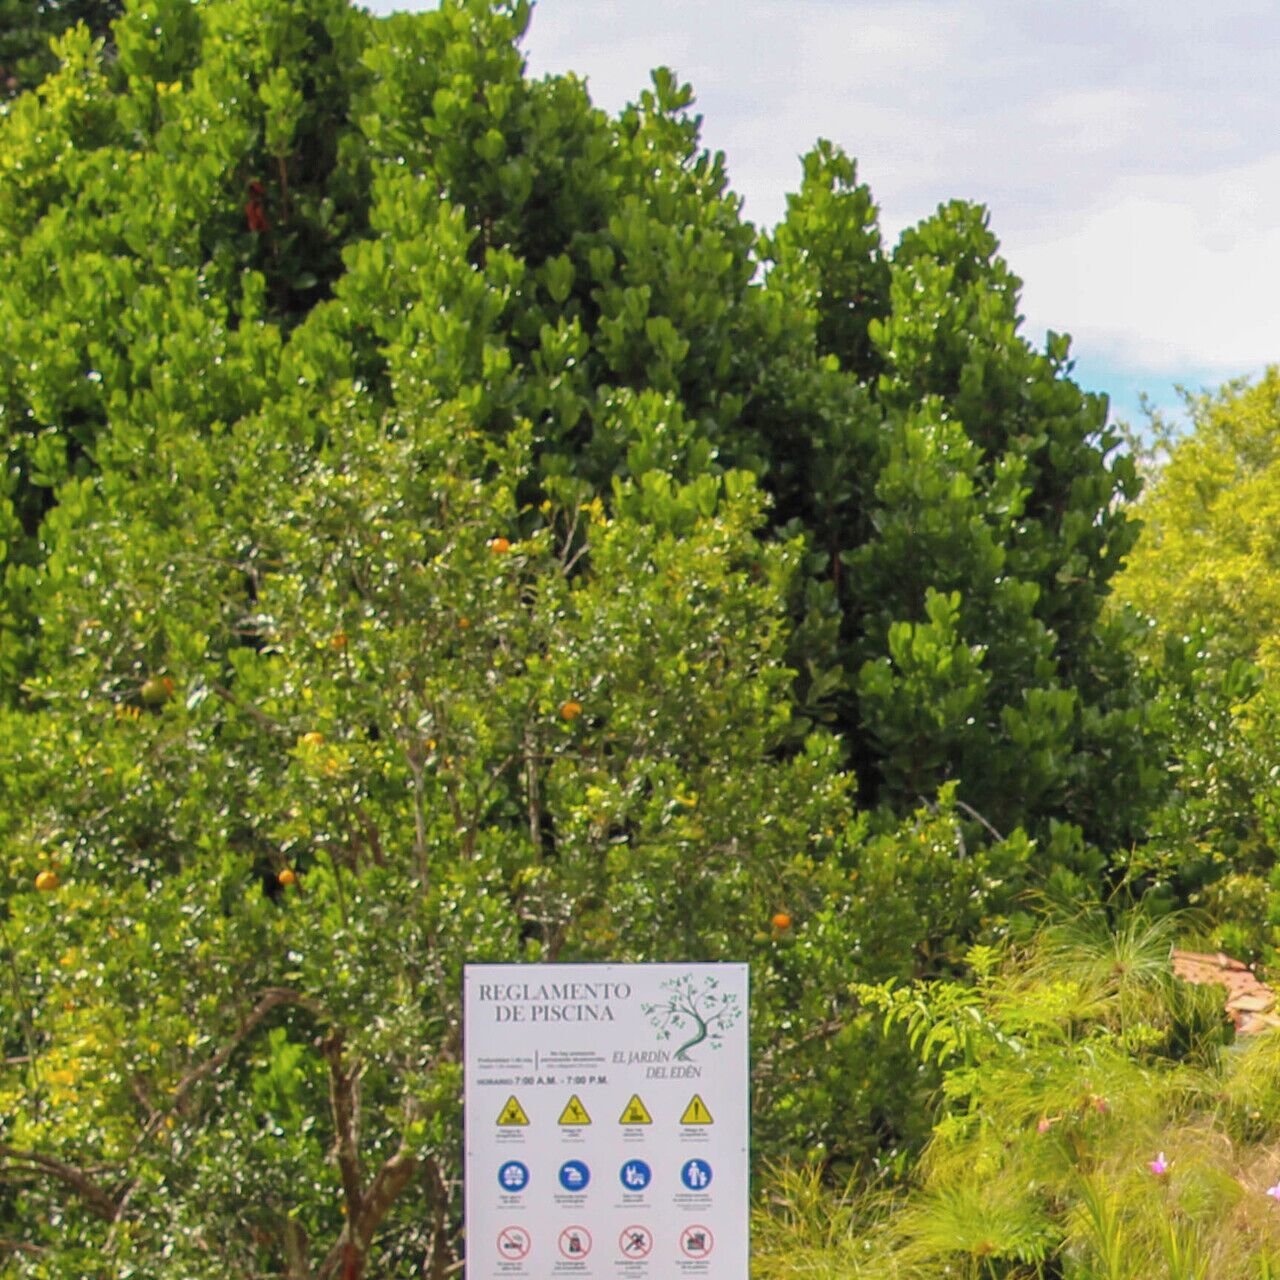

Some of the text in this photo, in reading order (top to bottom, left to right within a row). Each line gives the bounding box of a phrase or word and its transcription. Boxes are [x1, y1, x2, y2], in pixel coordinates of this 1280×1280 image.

[479, 983, 631, 1001] REGLAMENTO
[495, 1005, 614, 1022] DE PISCINA
[612, 1049, 670, 1066] EL JARDÍN
[514, 1076, 535, 1085] 7:00
[567, 1076, 587, 1085] 7:00
[646, 1066, 667, 1079] DEL
